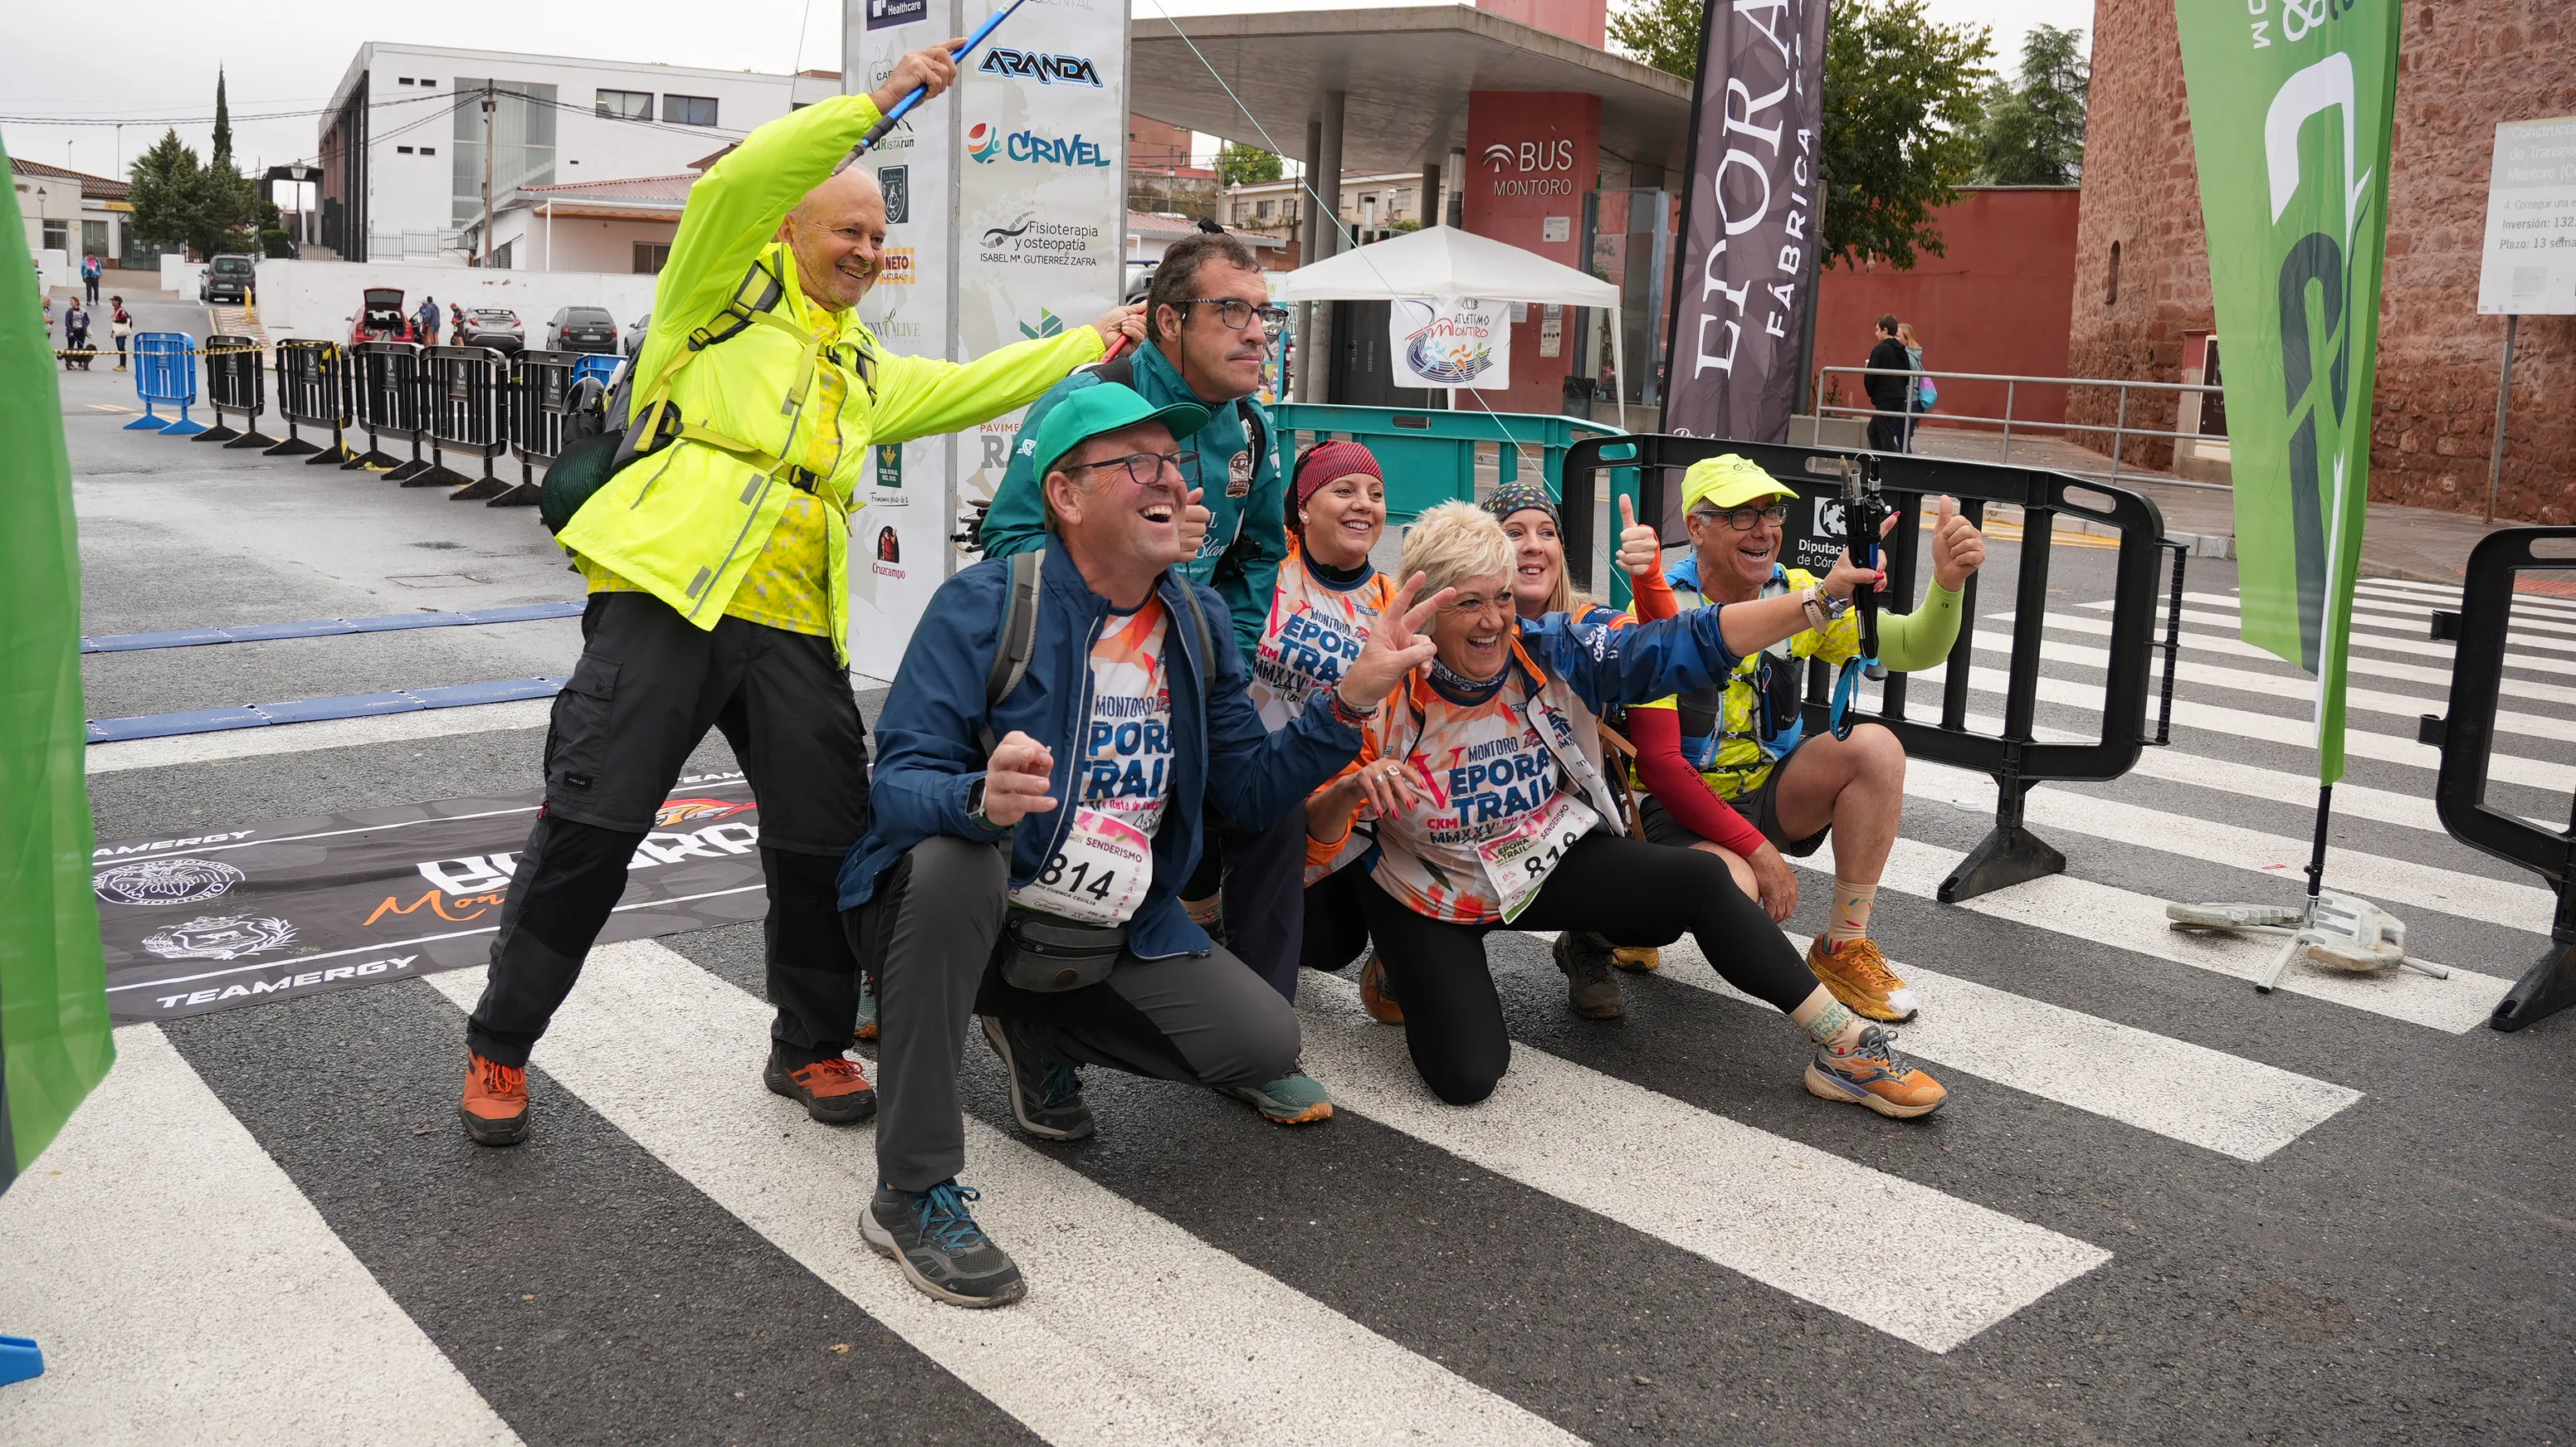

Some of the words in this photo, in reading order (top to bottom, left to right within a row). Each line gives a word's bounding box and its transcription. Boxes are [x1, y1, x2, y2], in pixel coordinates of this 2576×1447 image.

[888, 1, 921, 16] Healthcare
[980, 49, 1101, 86] ARANDA
[1008, 129, 1111, 167] CRIVEL
[1519, 139, 1573, 173] BUS
[2509, 148, 2525, 161] de
[2506, 168, 2555, 182] Montoro
[1494, 178, 1573, 197] MONTORO
[1694, 0, 1789, 379] EPORA
[2515, 199, 2552, 212] Conseguir
[2554, 199, 2569, 208] una
[1029, 221, 1099, 239] Fisioterapia
[1765, 129, 1812, 338] FÁBRICA
[2502, 217, 2549, 230] Inversión:
[1014, 238, 1022, 251] y
[1023, 236, 1086, 252] osteopatía
[2500, 239, 2530, 250] Plazo:
[2533, 238, 2547, 249] 13
[883, 256, 909, 270] NETO
[980, 252, 1008, 263] ISABEL
[1023, 254, 1070, 266] GUTIERREZ
[1071, 256, 1097, 266] ZAFRA
[1797, 553, 1811, 565] de
[872, 563, 905, 580] Cruzcampo
[1310, 607, 1350, 637] MONTORO
[1278, 635, 1354, 683] TRA
[1252, 656, 1306, 694] MMXXV
[1095, 694, 1154, 718] MONTORO
[1468, 736, 1520, 762] MONTORO
[1409, 747, 1466, 810] V
[1448, 747, 1550, 797] EPORA
[1110, 799, 1129, 811] Ruta
[1451, 773, 1555, 827] TRAIL
[1427, 817, 1458, 830] CXM
[1430, 821, 1495, 845] MMXXV
[1540, 804, 1569, 840] SENDERISMO
[1086, 837, 1143, 863] SENDERISMO
[1498, 838, 1530, 855] EPORA
[1501, 845, 1529, 861] TRAIL
[1038, 853, 1116, 901] 814
[135, 882, 225, 905] MONTORO
[1046, 887, 1071, 899] CUENCA
[1072, 895, 1096, 906] CECILIA
[363, 887, 507, 926] Mon
[156, 954, 419, 1009] TEAMERGY
[1811, 1003, 1844, 1037] EPORA
[1816, 1011, 1850, 1040] TRAIL
